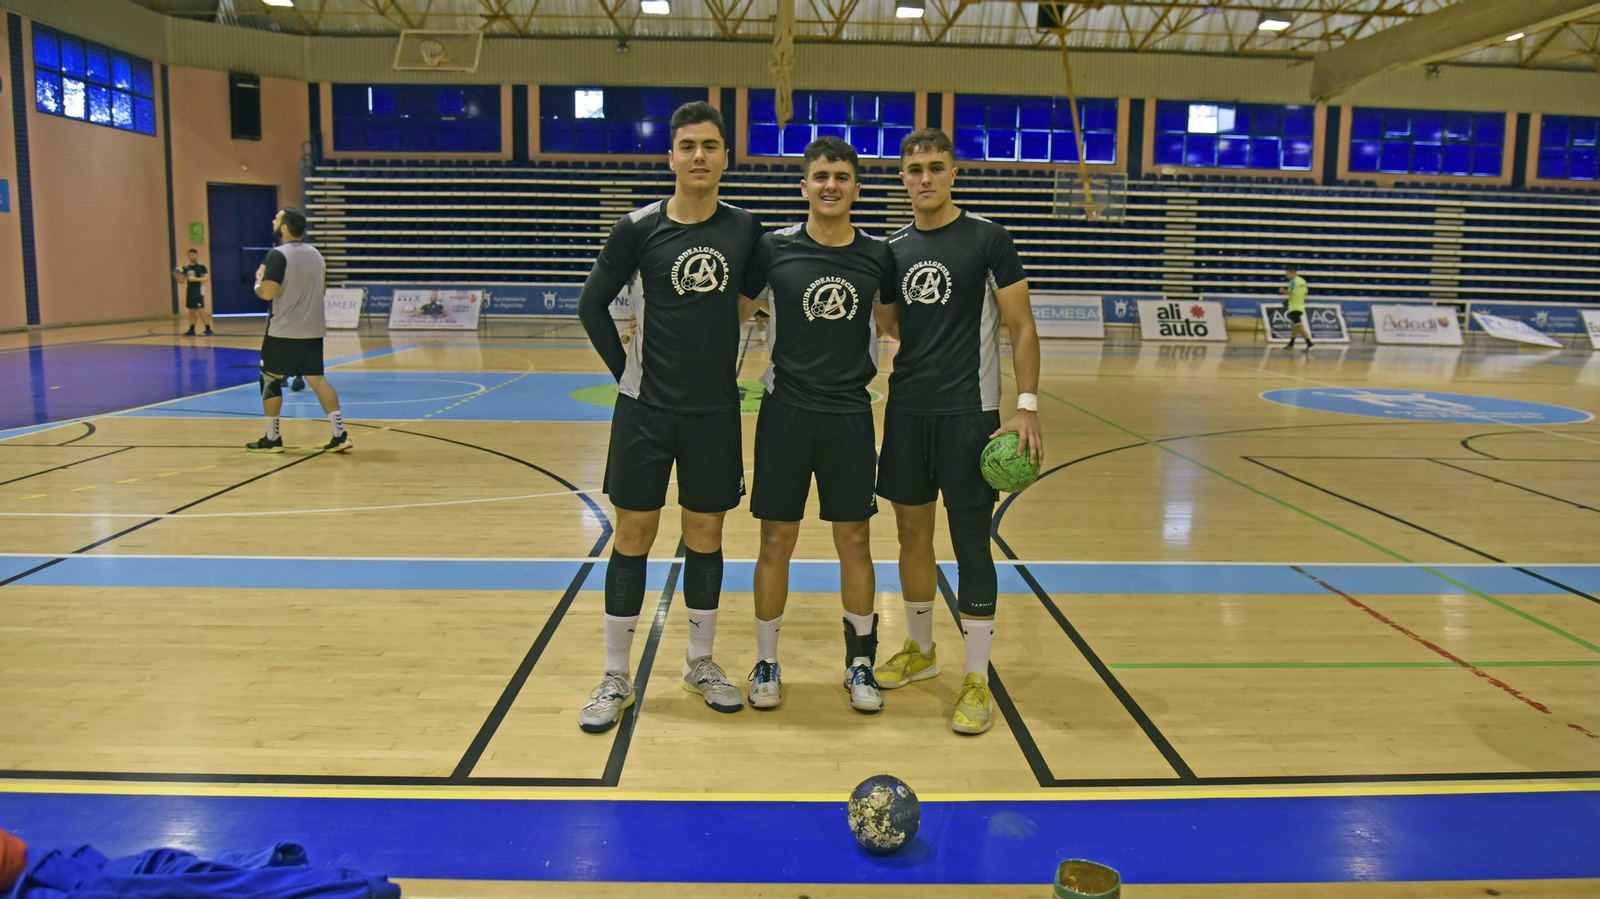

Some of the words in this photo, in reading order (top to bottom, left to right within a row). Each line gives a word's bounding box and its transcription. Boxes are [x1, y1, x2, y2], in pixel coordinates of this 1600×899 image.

[671, 246, 730, 296] BMCIUDADDEALGECIRAS.COM
[1032, 307, 1098, 319] REMESA
[1157, 303, 1181, 320] ali
[1311, 309, 1337, 324] AC
[1159, 319, 1208, 337] auto
[1383, 314, 1437, 329] Adedi
